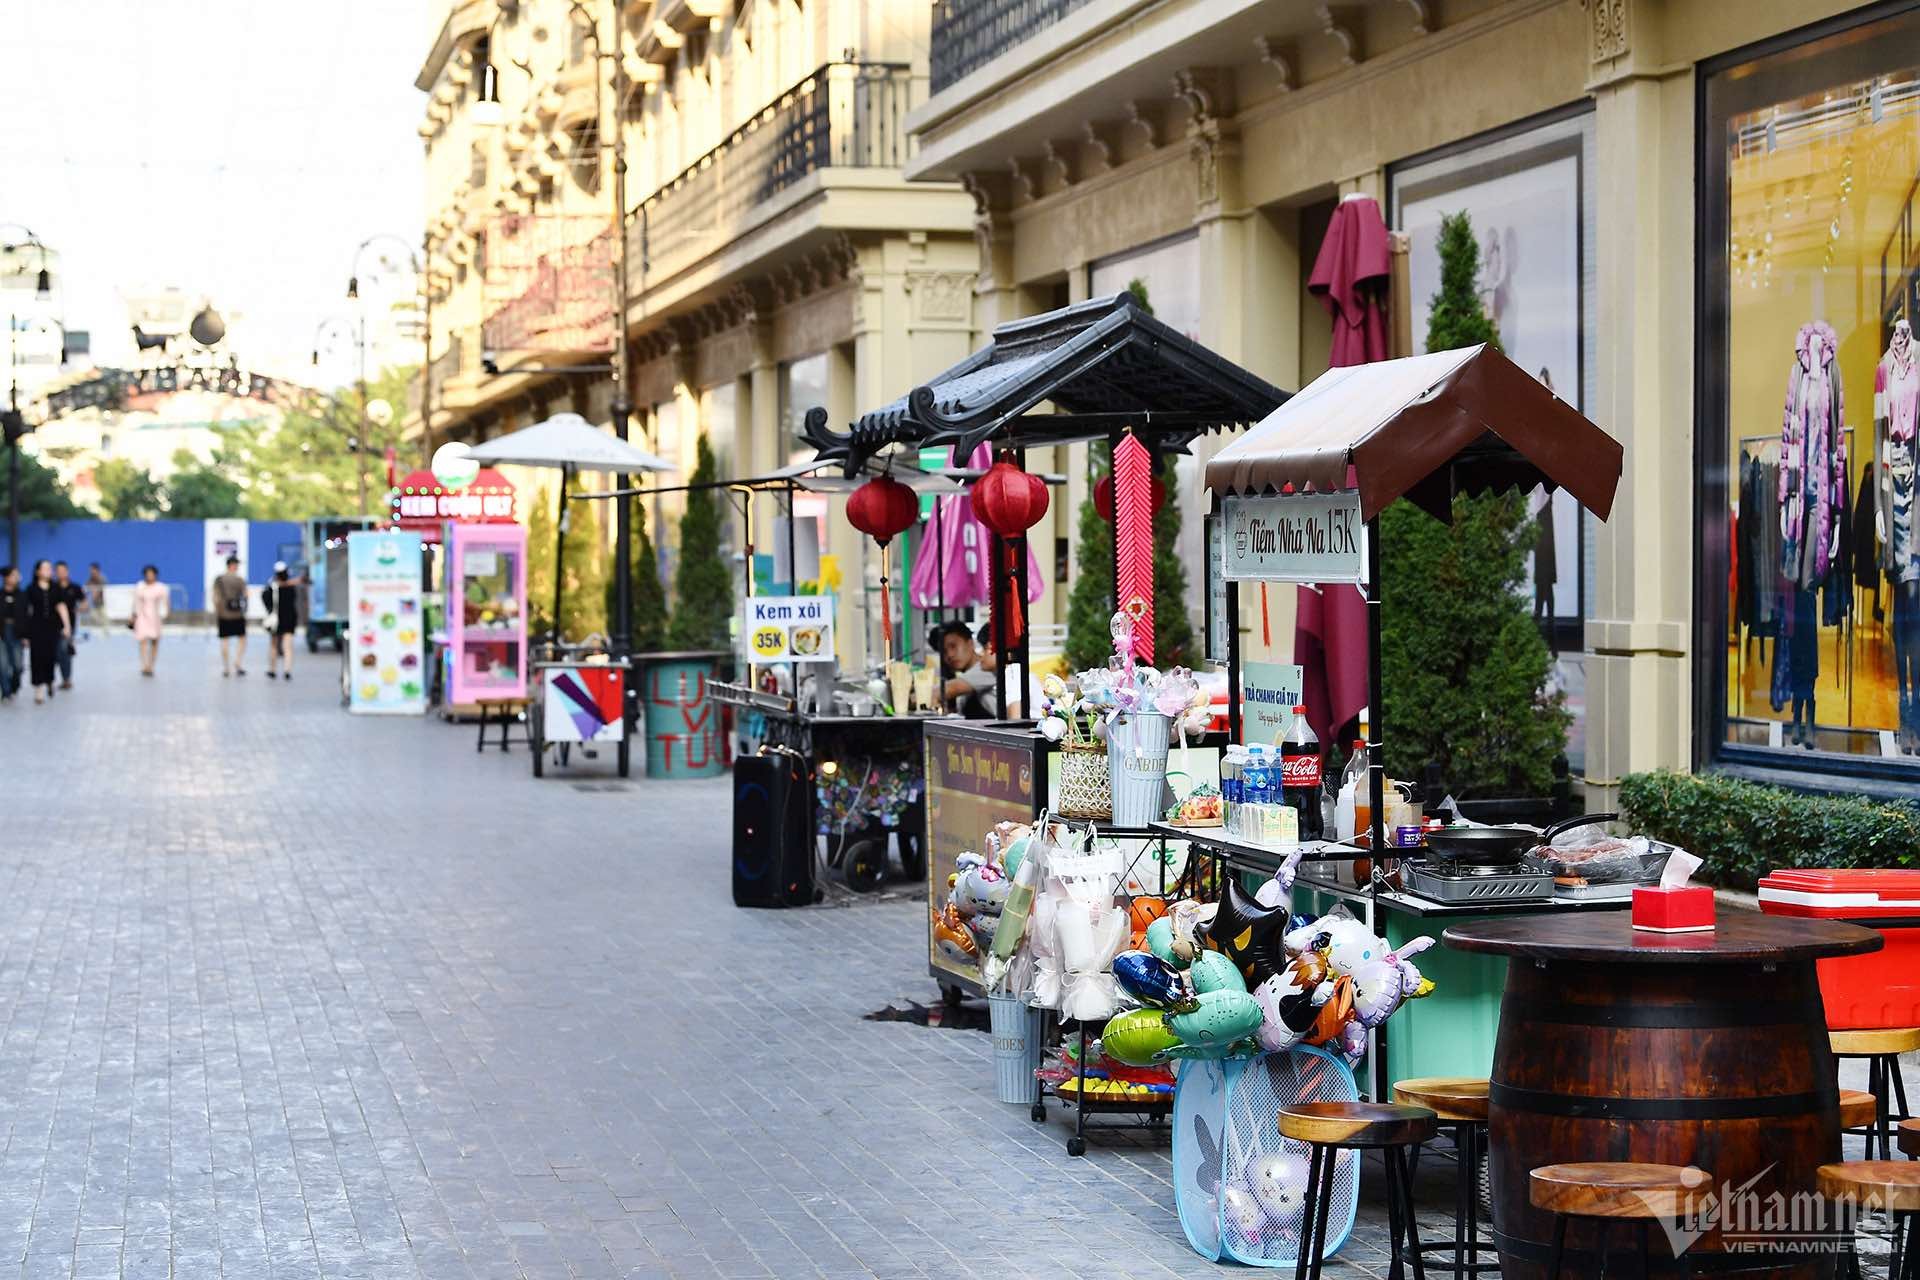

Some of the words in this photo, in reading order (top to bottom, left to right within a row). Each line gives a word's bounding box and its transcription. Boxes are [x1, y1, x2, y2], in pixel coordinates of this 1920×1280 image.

[1250, 518, 1276, 563] Tiệm
[1278, 518, 1304, 554] Nhà
[1306, 517, 1325, 554] Na
[1328, 508, 1357, 554] 15K
[756, 604, 792, 619] Kem
[756, 632, 782, 649] 35K
[1245, 682, 1255, 701] TRÀ
[1287, 692, 1299, 706] TAY
[1124, 757, 1165, 772] GARDE
